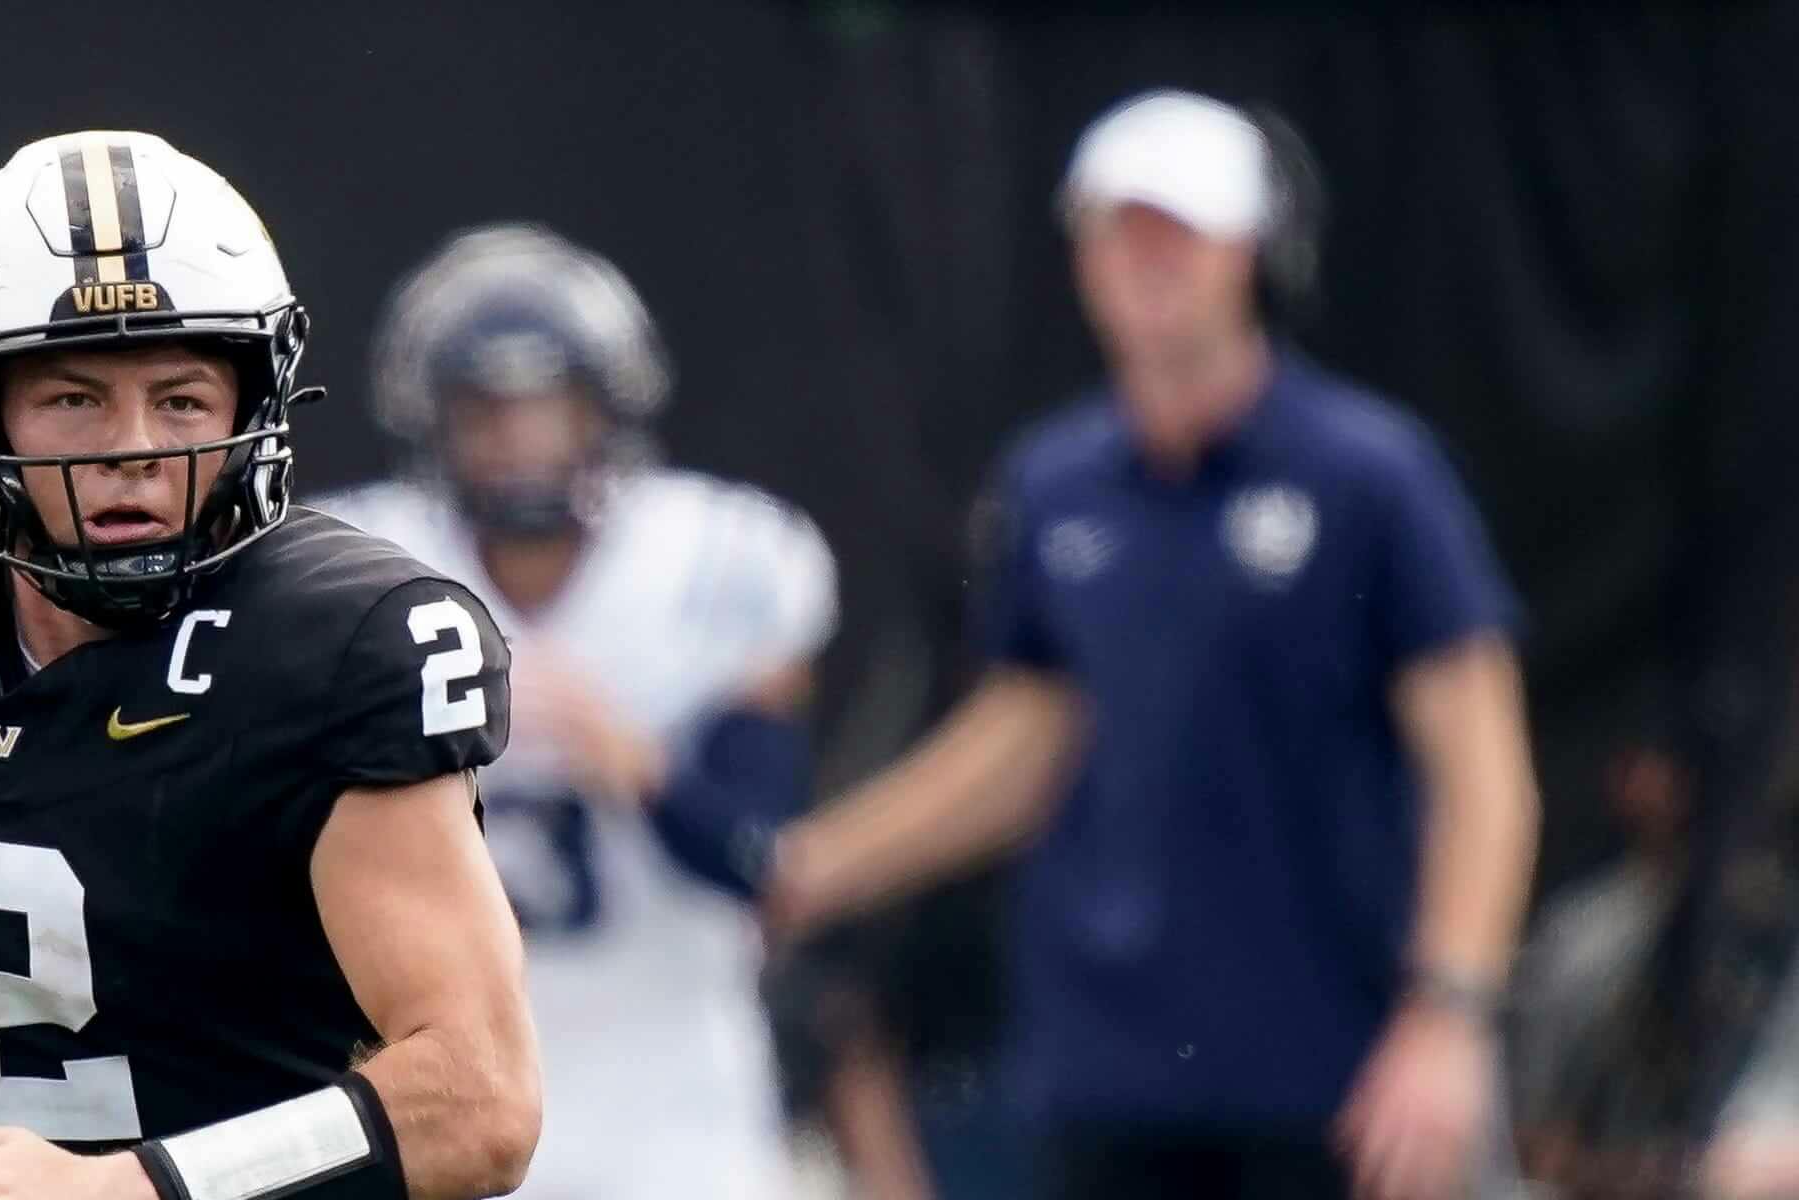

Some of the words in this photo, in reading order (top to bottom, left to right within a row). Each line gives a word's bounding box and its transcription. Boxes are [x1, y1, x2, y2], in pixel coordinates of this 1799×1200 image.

[72, 283, 158, 313] VUFB
[167, 610, 232, 694] C
[407, 596, 487, 736] 2
